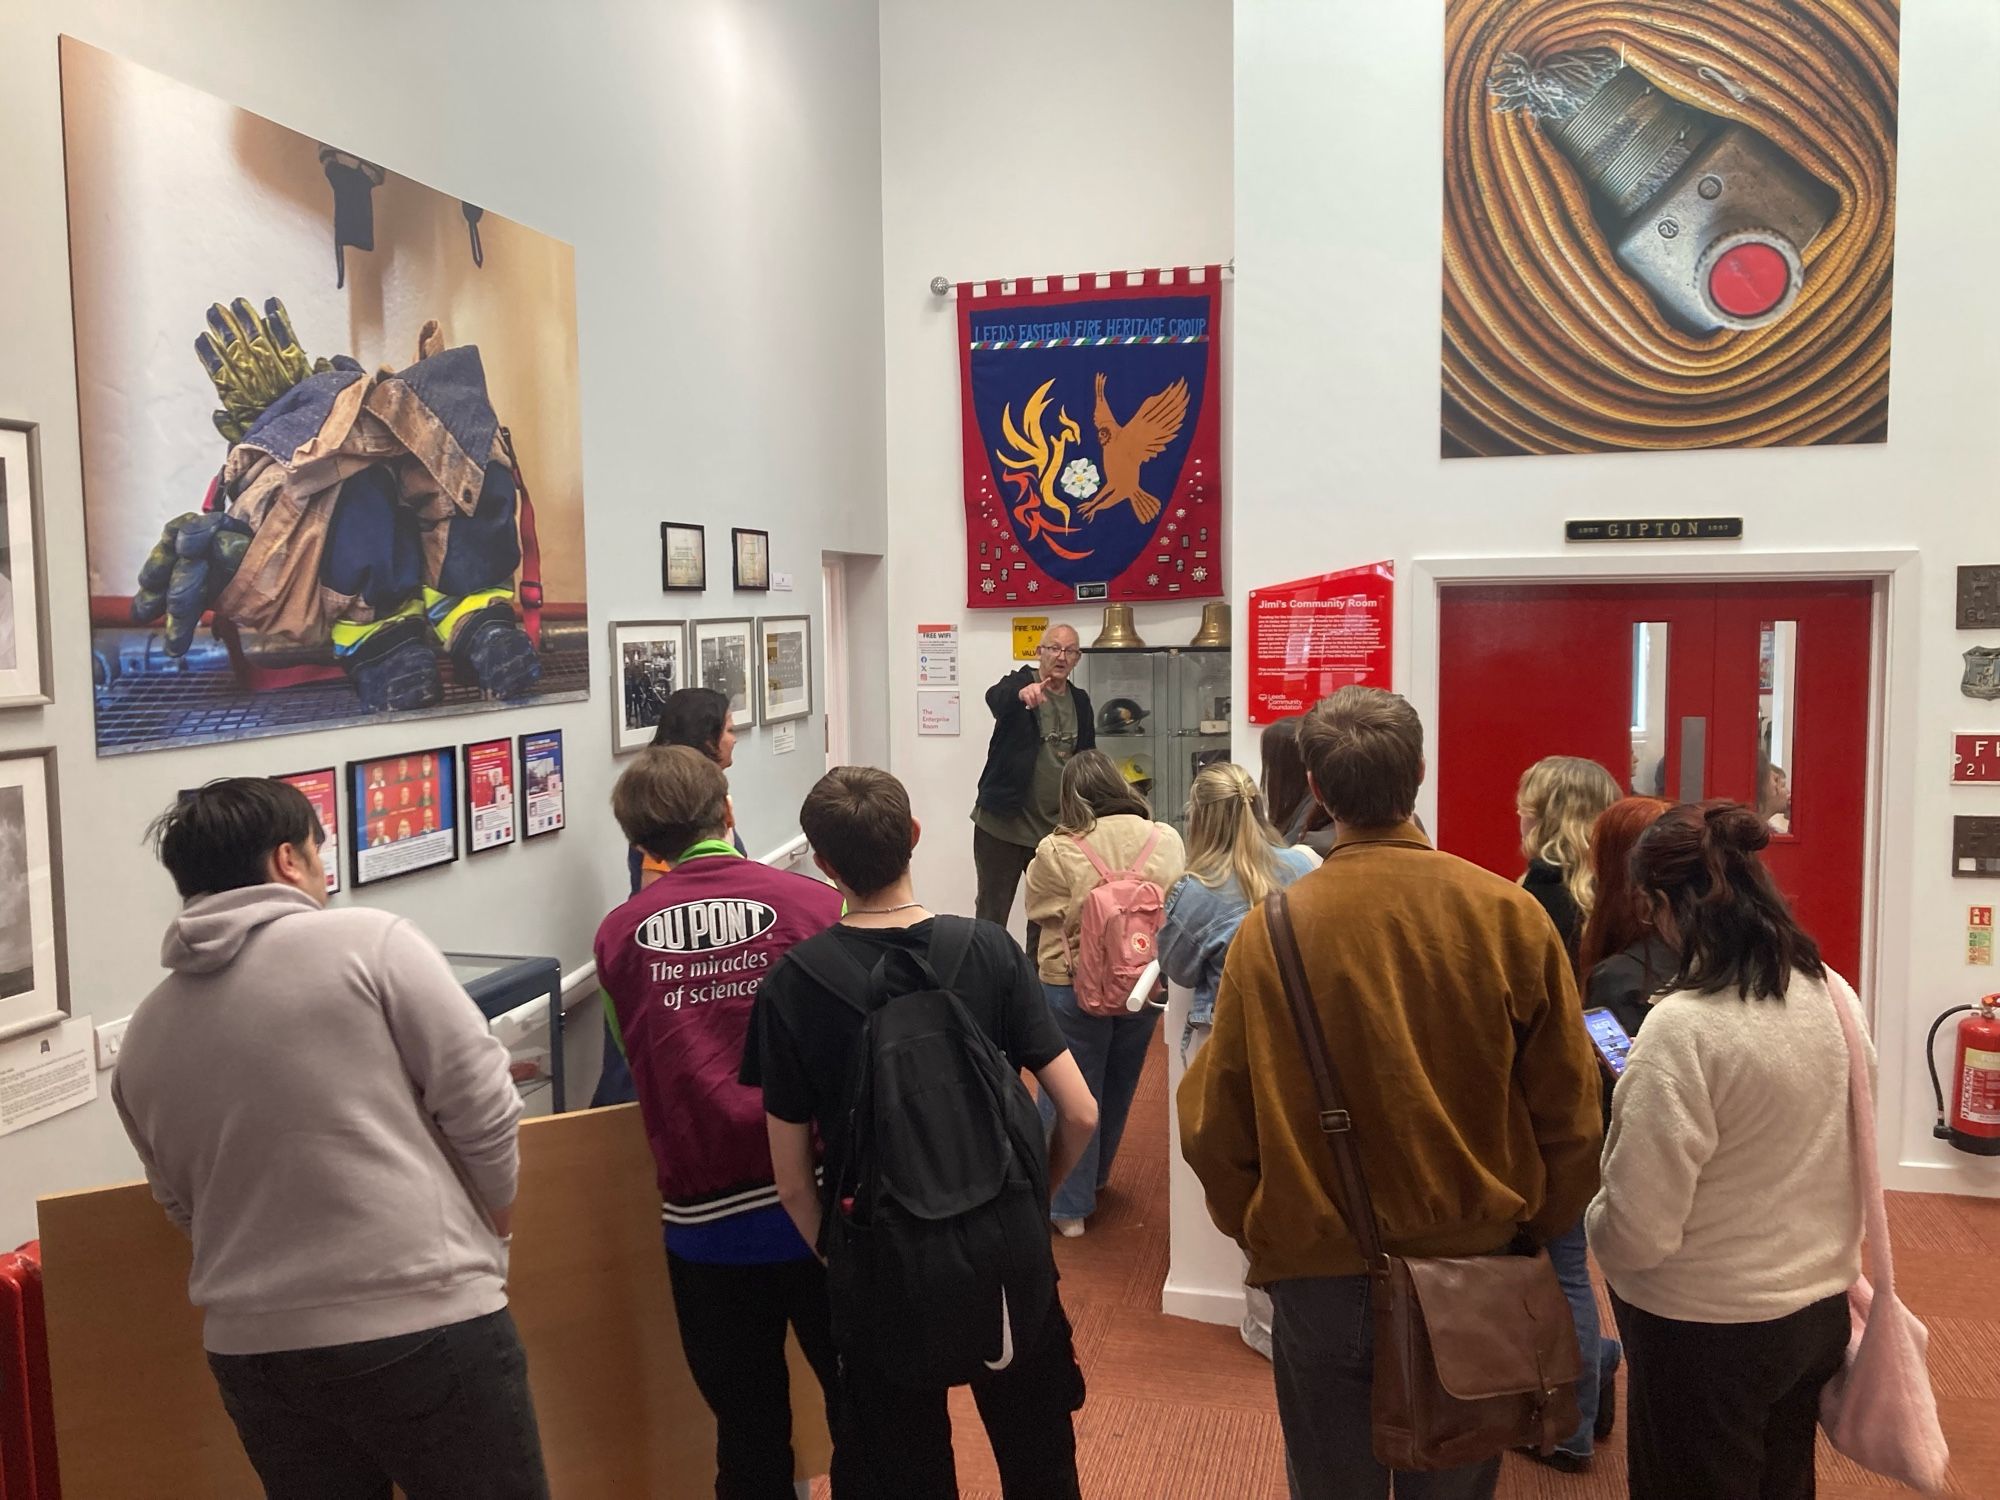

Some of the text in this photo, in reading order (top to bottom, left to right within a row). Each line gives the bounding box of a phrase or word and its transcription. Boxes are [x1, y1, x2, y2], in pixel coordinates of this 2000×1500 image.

[975, 324, 1015, 342] LEEDS
[1018, 321, 1070, 342] EASTERN
[1074, 319, 1102, 338] FIRE
[1106, 317, 1165, 337] HERITAGE
[1608, 522, 1699, 537] GIPTON
[1258, 599, 1378, 609] Jimi's Community Room
[649, 950, 769, 983] The miracles
[663, 984, 685, 1011] of
[1962, 1067, 1973, 1111] JACKSON
